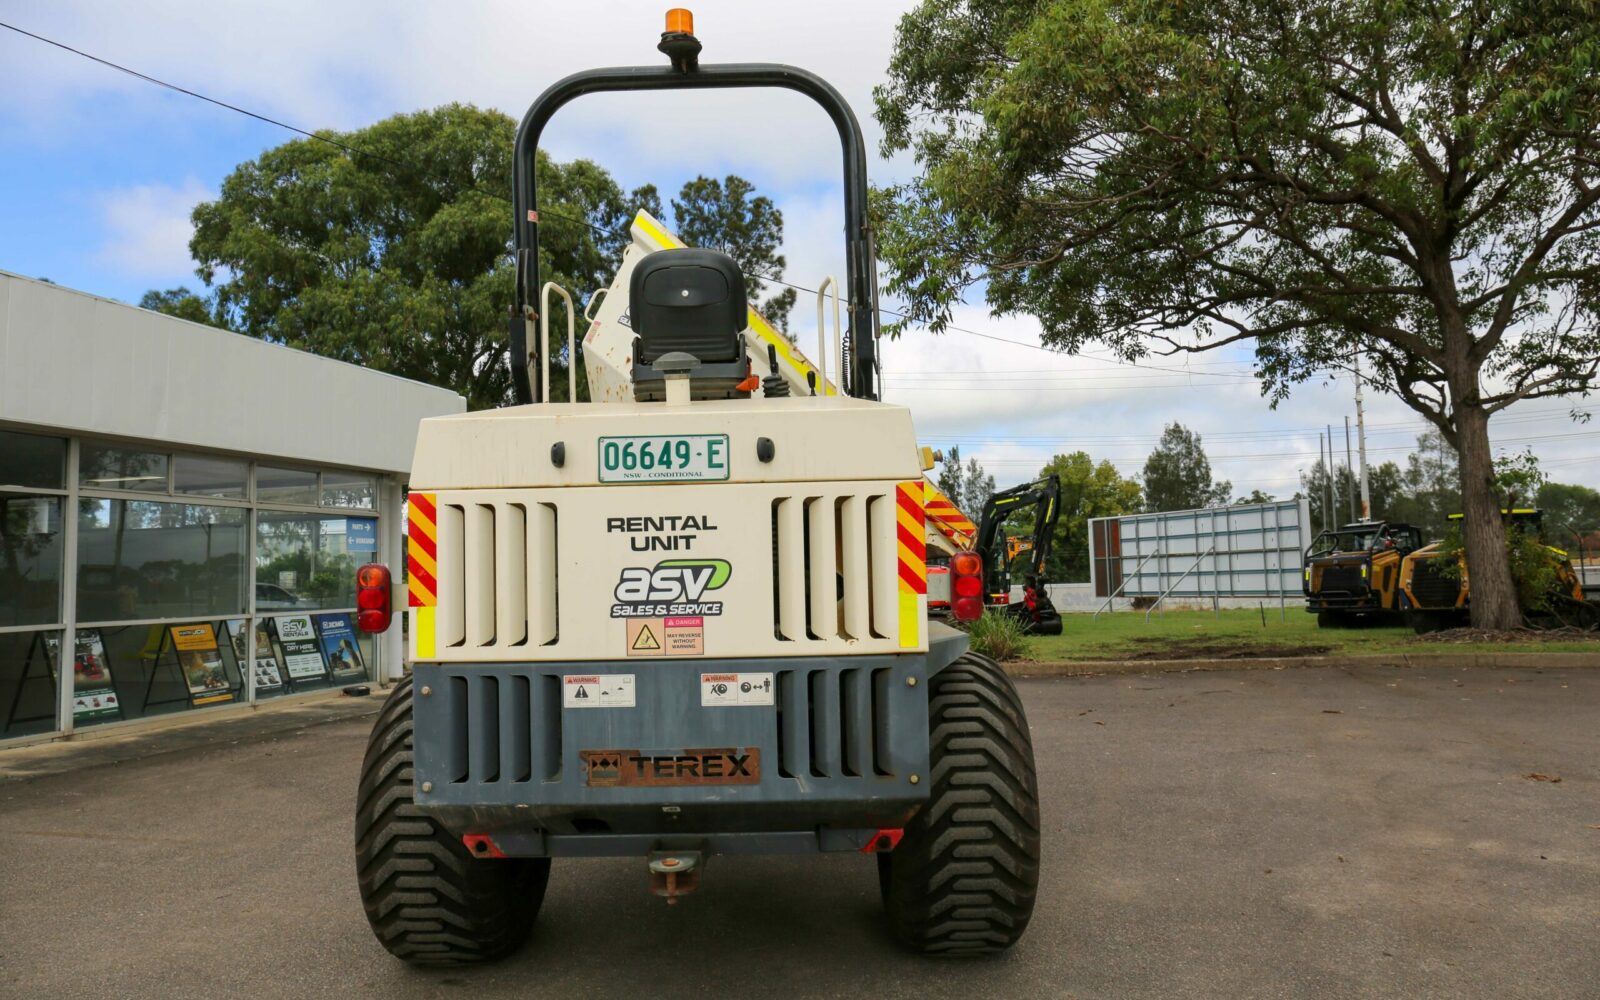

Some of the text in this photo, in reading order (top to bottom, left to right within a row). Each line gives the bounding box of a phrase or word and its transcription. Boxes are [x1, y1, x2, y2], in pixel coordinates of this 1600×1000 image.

[607, 515, 718, 532] RENTAL
[630, 535, 697, 551] UNIT
[655, 604, 667, 615] &
[669, 603, 721, 614] SERVICE
[629, 755, 751, 777] TEREX
